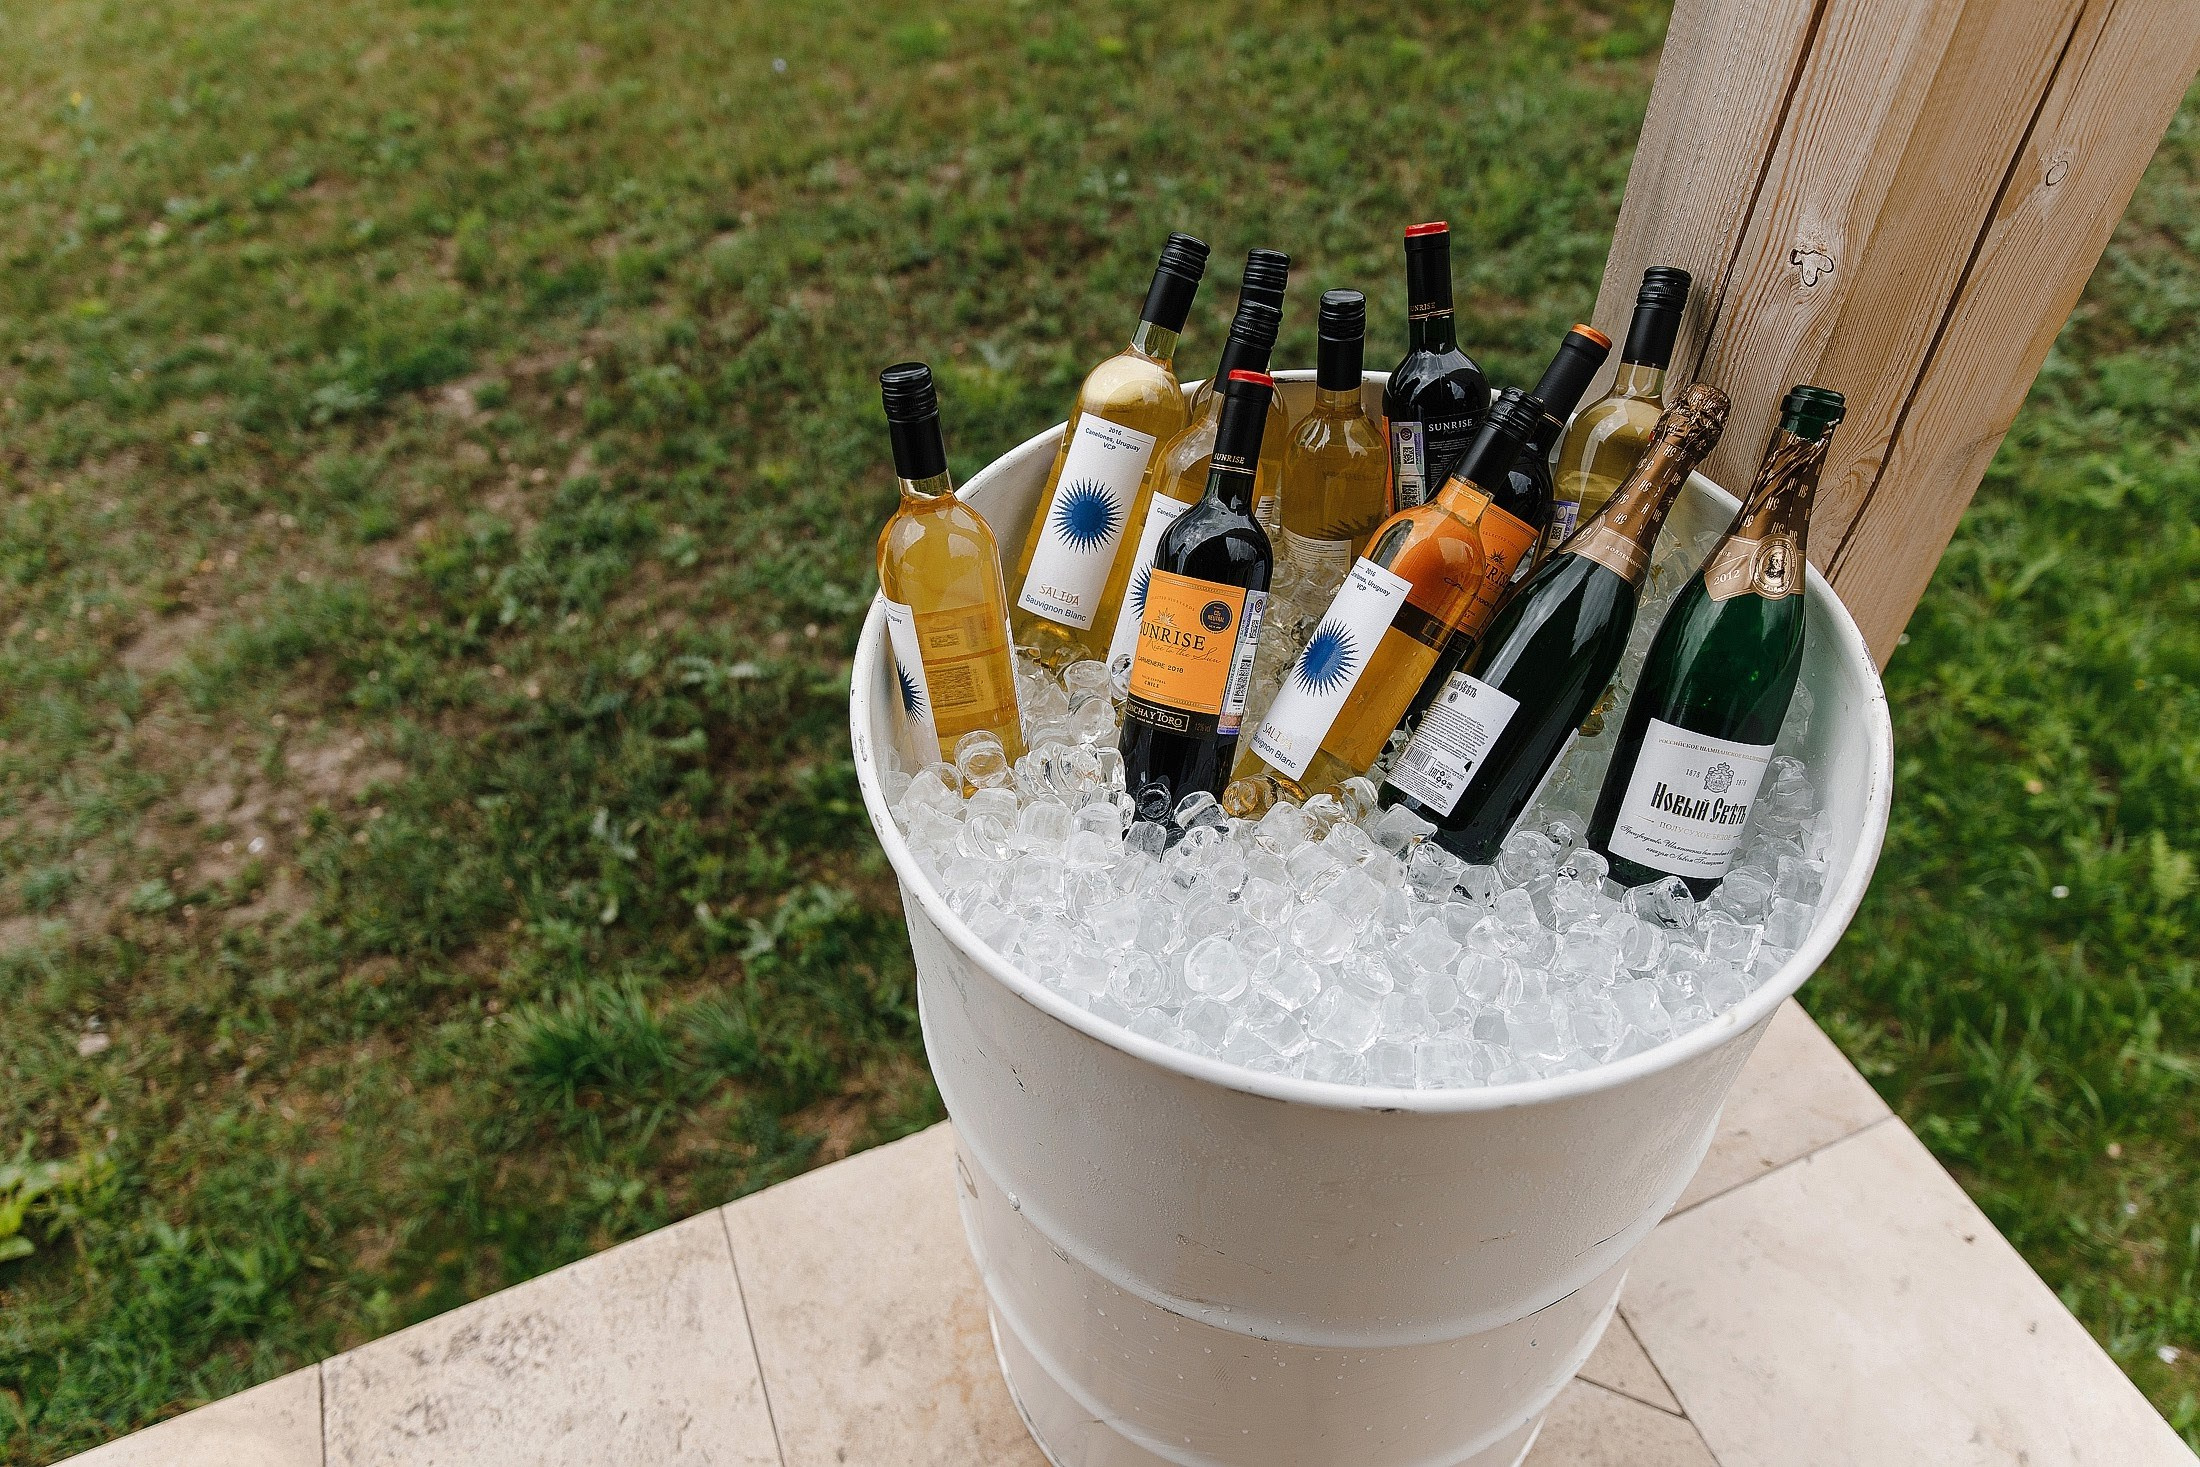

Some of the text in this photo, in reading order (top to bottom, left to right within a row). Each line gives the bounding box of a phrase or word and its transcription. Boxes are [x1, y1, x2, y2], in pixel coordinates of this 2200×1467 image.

[1408, 301, 1436, 312] UNRISE
[1108, 426, 1123, 436] 2016
[1428, 418, 1473, 432] SUNRISE
[1085, 427, 1141, 453] Canelones, Uruguay
[1103, 442, 1117, 451] VCP
[1713, 569, 1740, 586] 2012
[1039, 584, 1080, 606] SALIDA
[1356, 582, 1367, 591] VCP
[1367, 580, 1391, 597] Uruguay
[1025, 594, 1087, 622] Sauvignon Blanc
[1150, 711, 1157, 720] Y
[1156, 711, 1183, 728] TORO
[1274, 750, 1297, 769] Blanc
